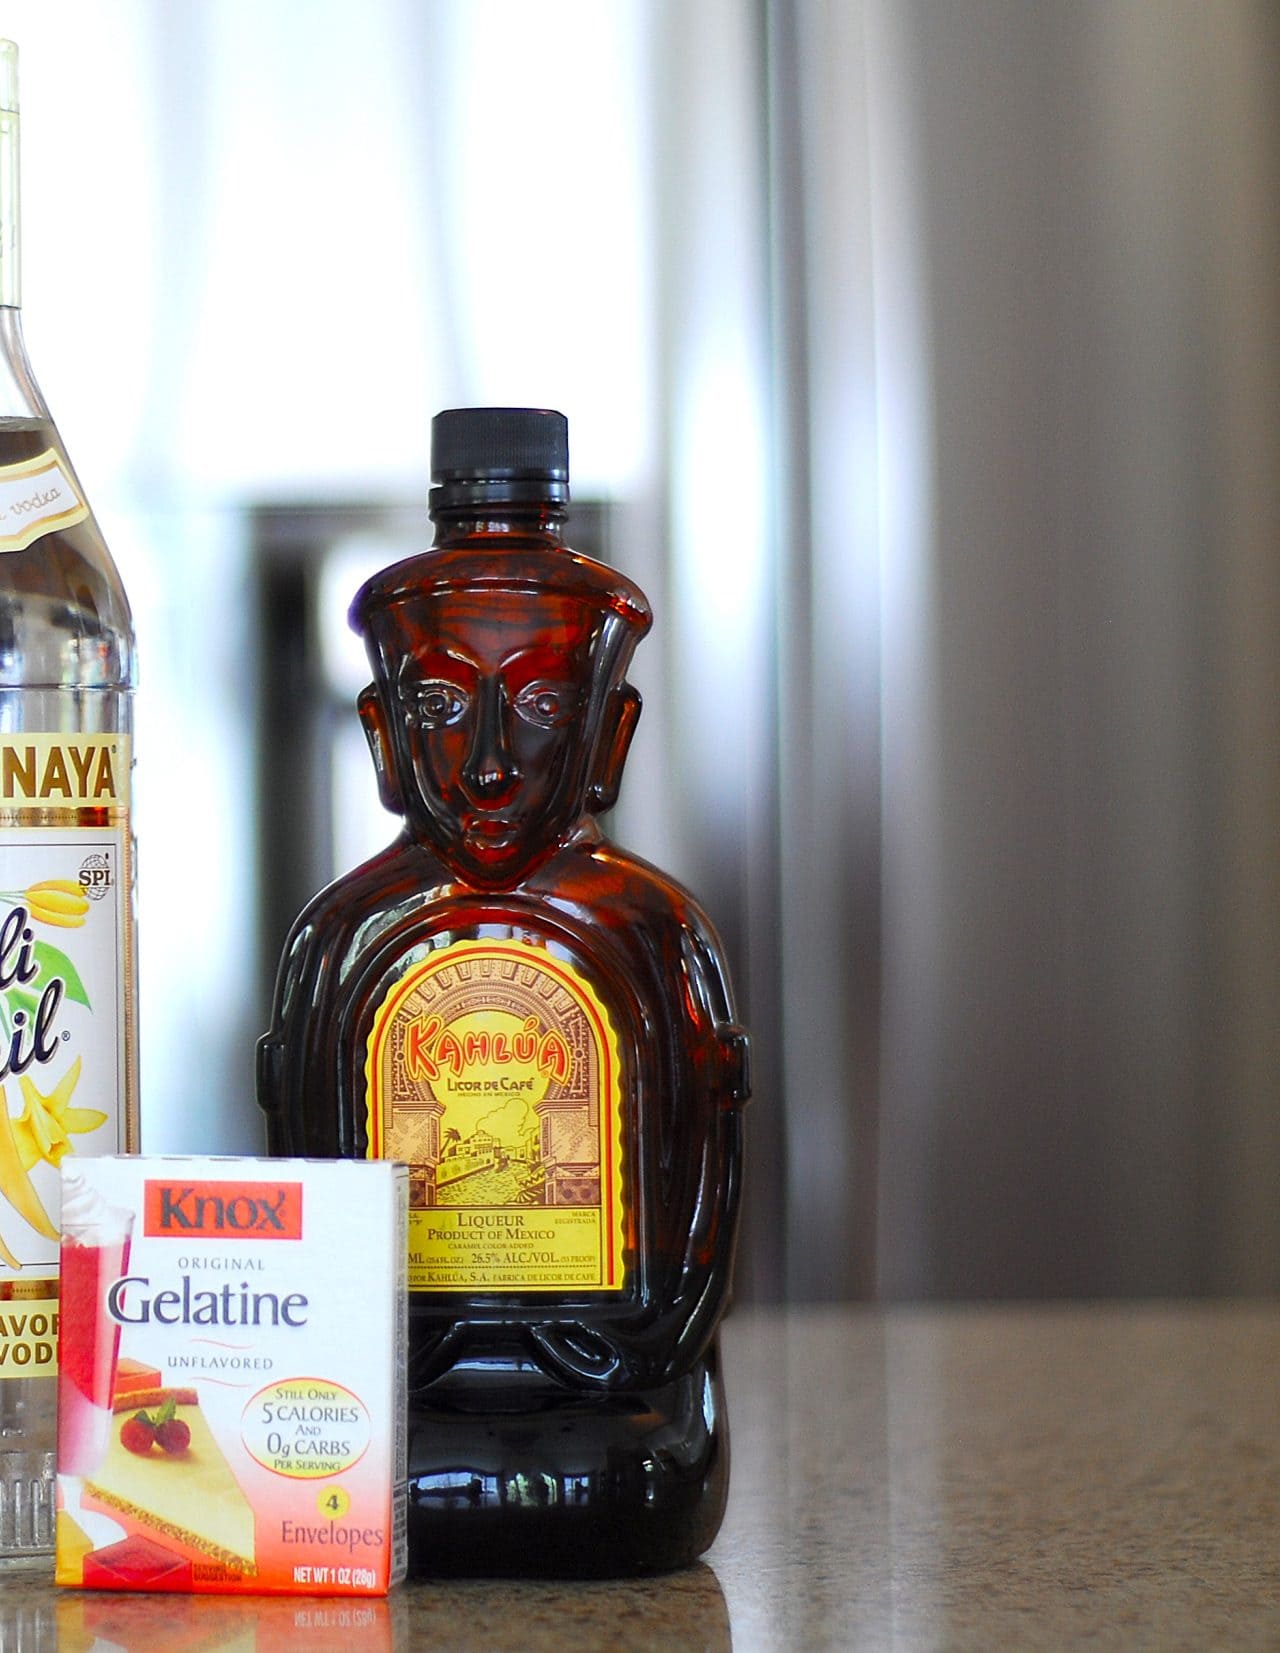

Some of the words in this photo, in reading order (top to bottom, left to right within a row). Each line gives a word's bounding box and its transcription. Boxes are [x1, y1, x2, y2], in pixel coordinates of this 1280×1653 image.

[9, 487, 62, 516] vodka
[78, 870, 111, 887] SPI
[406, 1015, 570, 1085] KAHLÚA
[447, 1078, 481, 1091] LICOR
[484, 1081, 498, 1091] DE
[500, 1077, 535, 1090] CAFÉ
[161, 1189, 286, 1231] Knox
[457, 1212, 524, 1228] LIQUEUR
[428, 1228, 484, 1240] PRODUCT
[487, 1230, 502, 1240] OF
[506, 1228, 555, 1240] MEXICO
[178, 1257, 265, 1271] ORIGINAL
[109, 1276, 308, 1327] Gelatine
[168, 1356, 273, 1369] UNFLAVORED
[262, 1402, 273, 1424] 5
[276, 1406, 359, 1422] CALORIES
[294, 1440, 350, 1456] CARBS
[327, 1496, 339, 1510] 4
[282, 1521, 384, 1554] Envelopes
[294, 1567, 312, 1583] NET
[312, 1568, 329, 1584] WT
[331, 1568, 336, 1584] 1
[338, 1568, 351, 1585] OZ
[352, 1568, 376, 1588] (28g)
